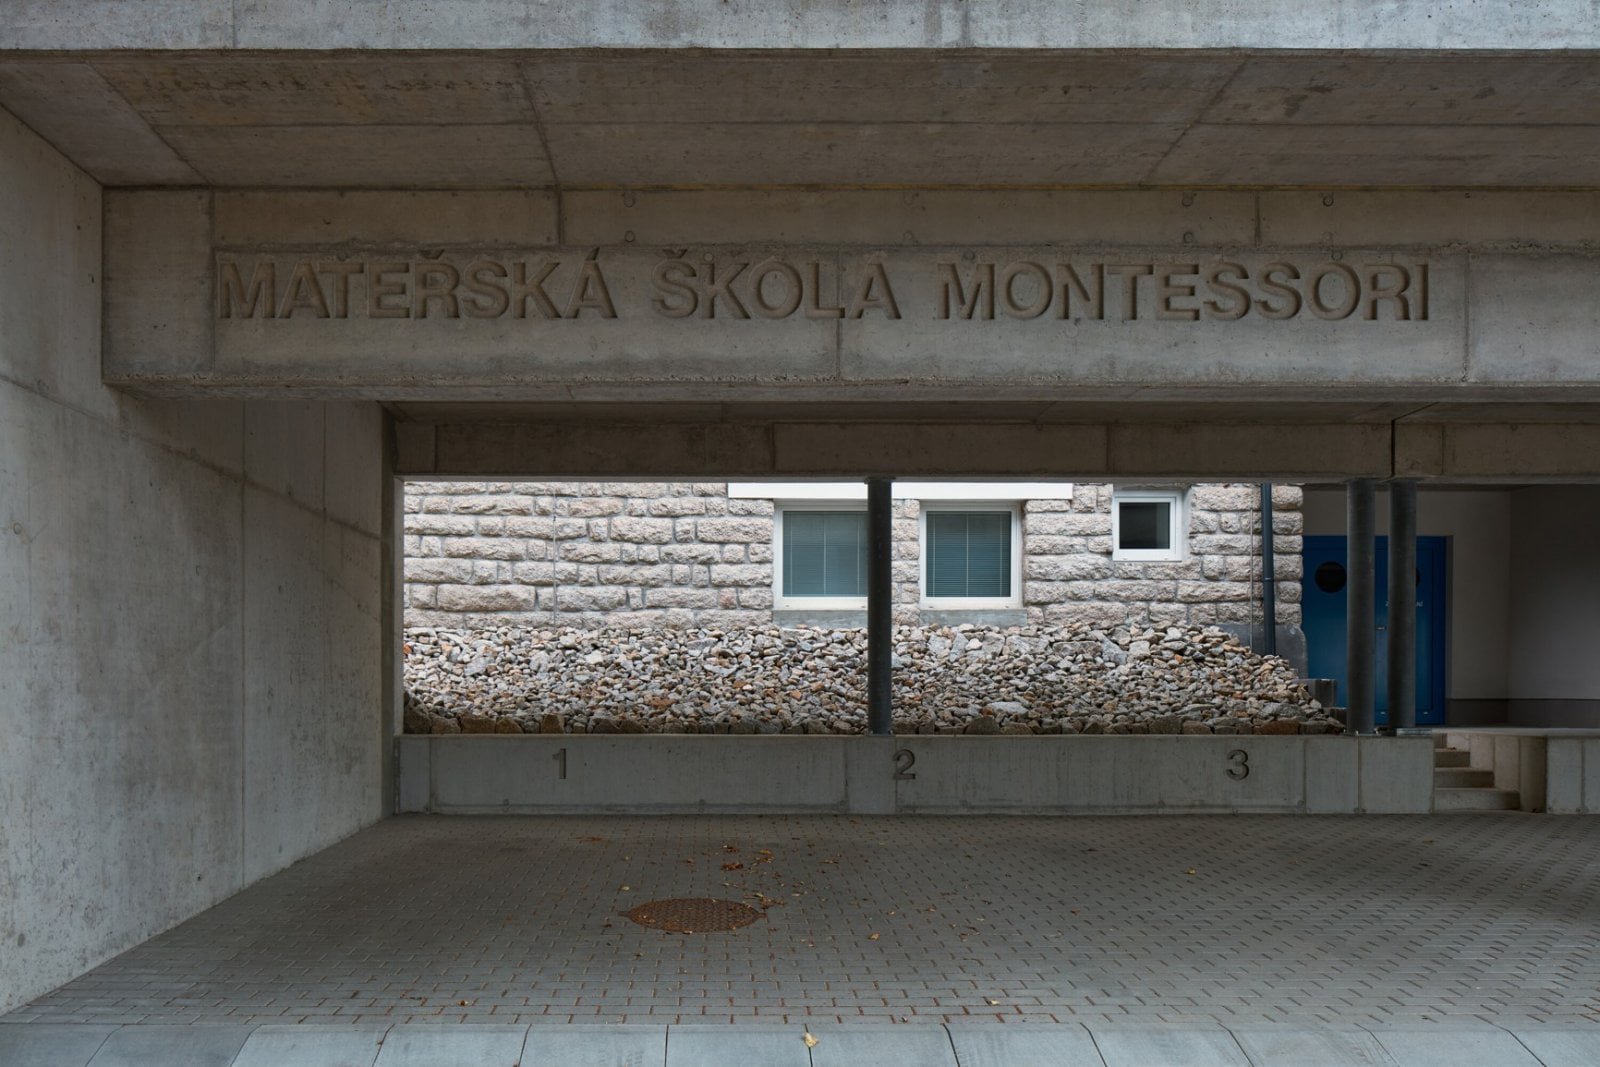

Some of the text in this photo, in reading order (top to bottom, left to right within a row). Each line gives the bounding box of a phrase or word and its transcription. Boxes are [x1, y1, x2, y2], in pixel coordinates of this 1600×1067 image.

[218, 247, 1430, 321] MATEŘSKÁ ŠKOLA MONTESSORI
[552, 748, 567, 780] 1
[892, 748, 917, 780] 2
[1225, 749, 1250, 781] 3
